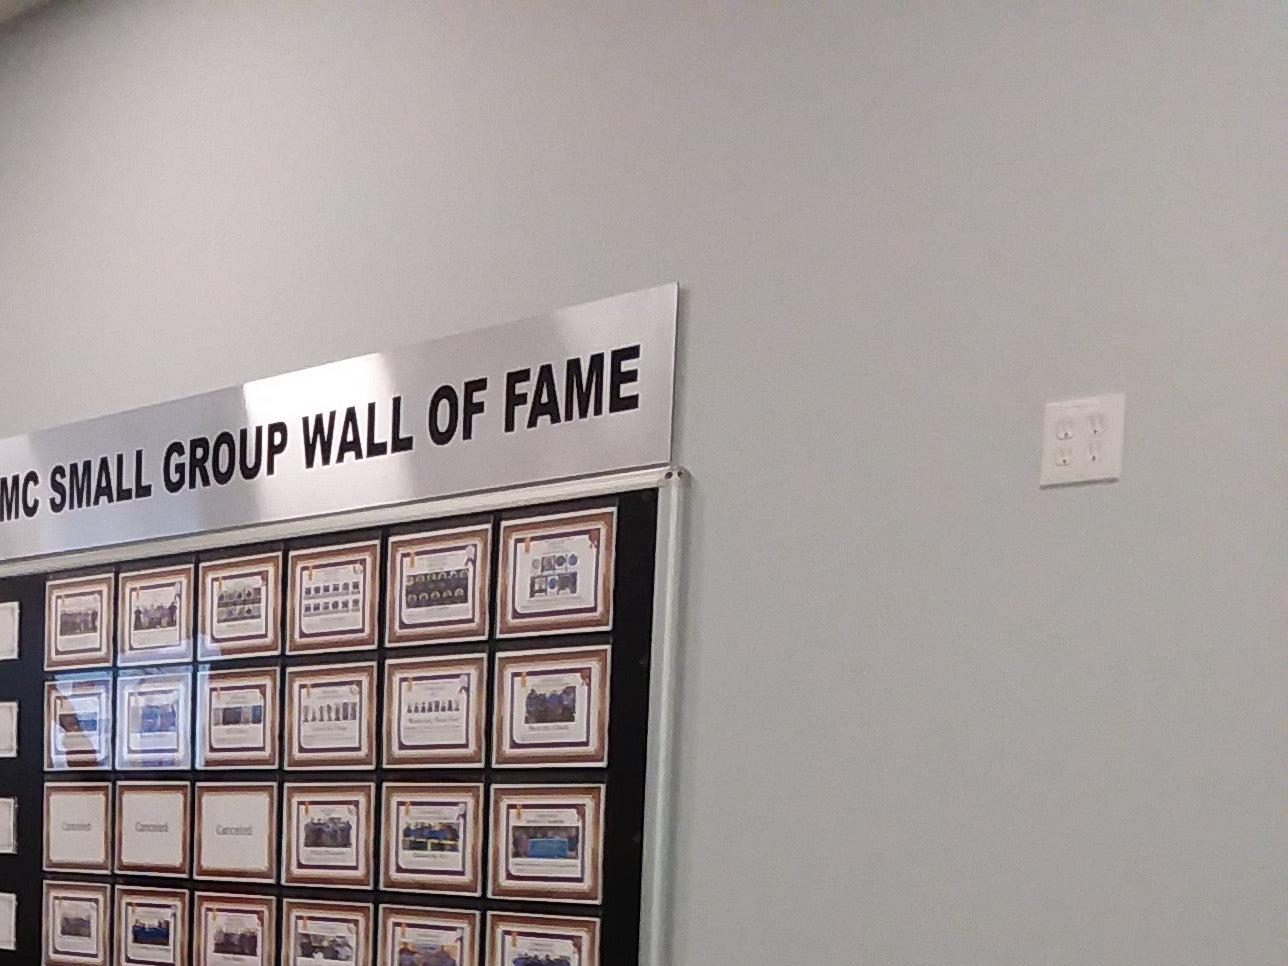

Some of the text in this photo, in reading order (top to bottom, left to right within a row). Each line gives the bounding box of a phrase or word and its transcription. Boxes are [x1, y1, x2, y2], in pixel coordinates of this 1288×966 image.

[49, 449, 153, 514] SMALL
[162, 421, 289, 495] GROUP
[301, 395, 414, 470] WALL
[427, 376, 488, 446] OF
[503, 343, 641, 434] FAME
